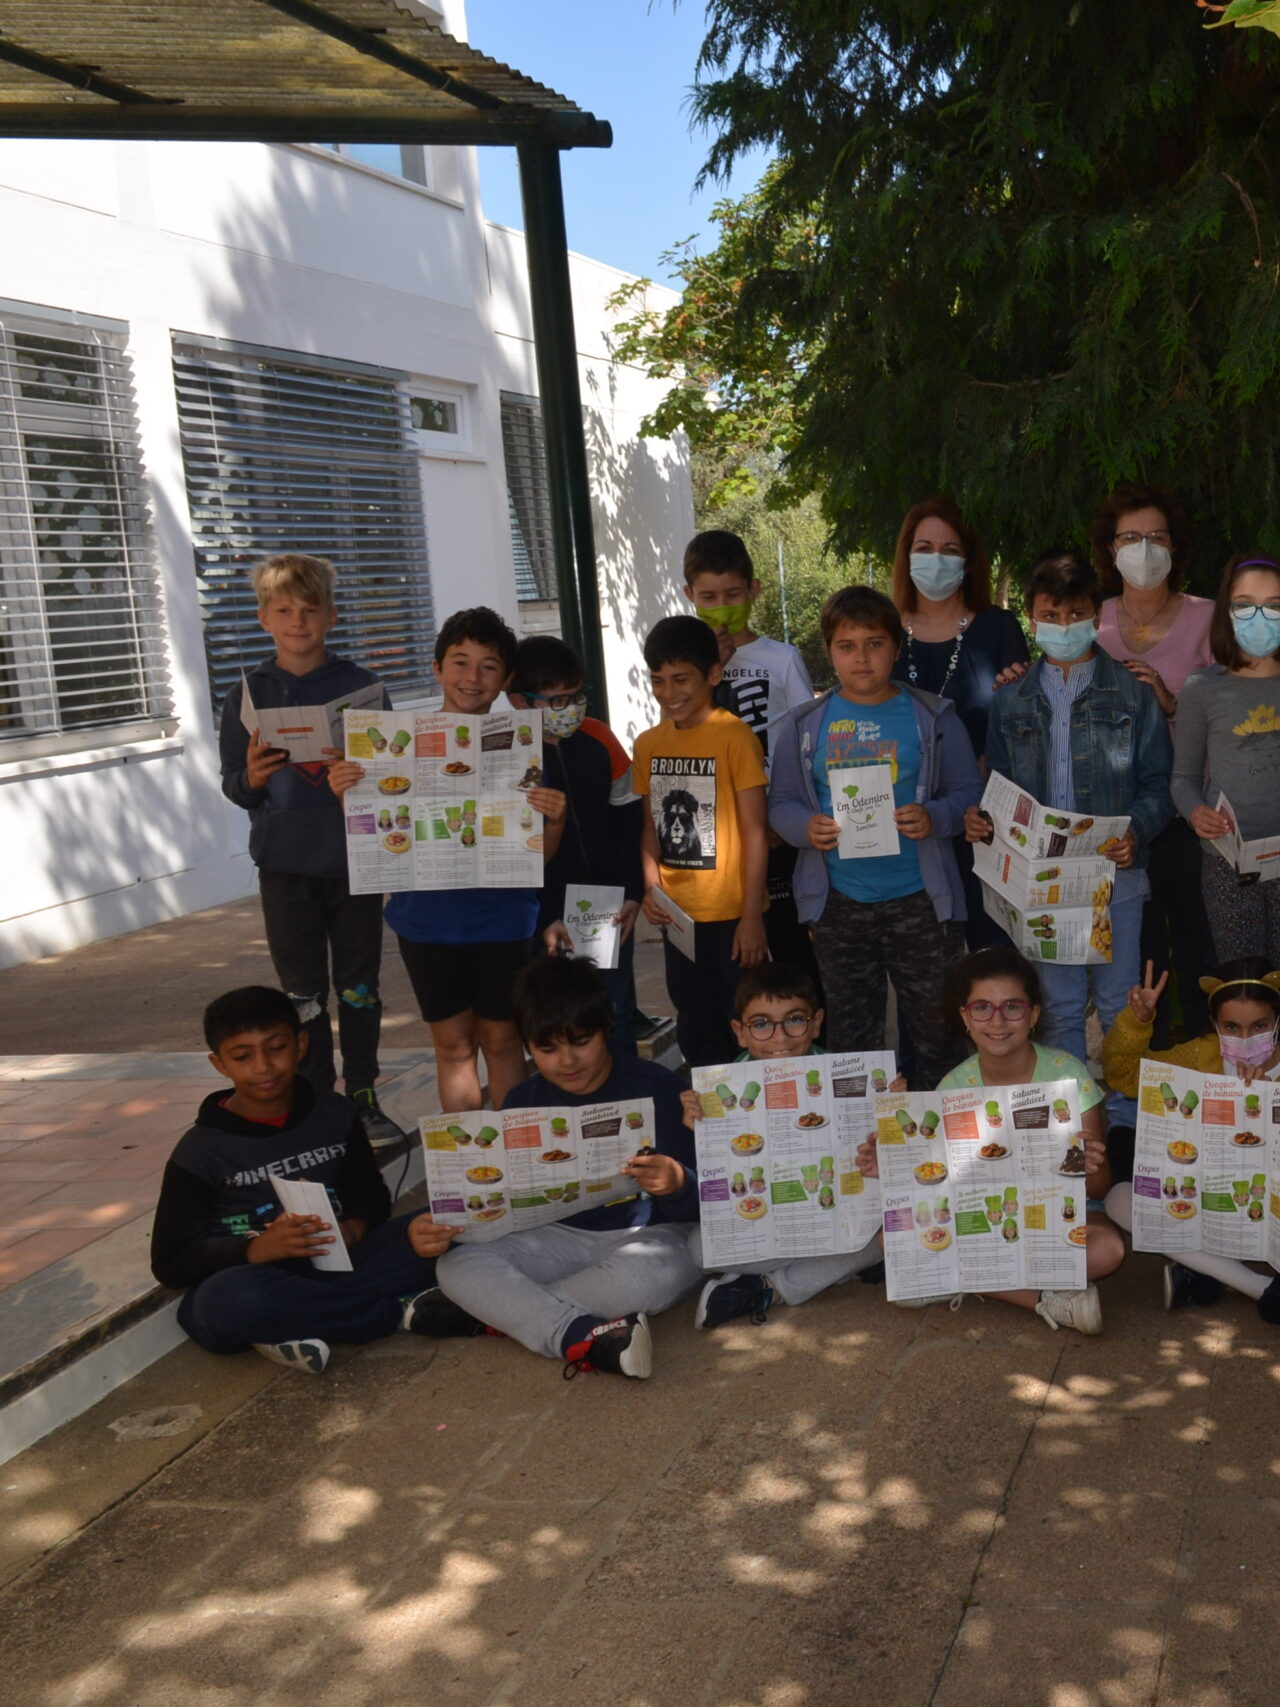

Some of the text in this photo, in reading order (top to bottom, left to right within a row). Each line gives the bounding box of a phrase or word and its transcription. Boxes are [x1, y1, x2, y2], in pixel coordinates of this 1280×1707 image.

[723, 669, 769, 678] NGELES
[828, 719, 856, 734] AFRO
[651, 758, 716, 775] BROOKLYN
[349, 803, 372, 813] Crepes
[837, 794, 890, 812] Em Odemira
[1036, 837, 1045, 858] Cookies
[567, 911, 618, 923] Em Odemira
[1204, 1080, 1236, 1090] Queques
[942, 1092, 974, 1105] Queques
[1011, 1087, 1041, 1100] Salame
[1213, 1088, 1244, 1098] banana
[953, 1099, 983, 1111] banana
[225, 1143, 347, 1186] MINECRAFT
[1138, 1163, 1160, 1174] Crepes
[702, 1166, 725, 1178] Crepes
[434, 1189, 460, 1199] Crepes
[886, 1195, 910, 1208] Crepes
